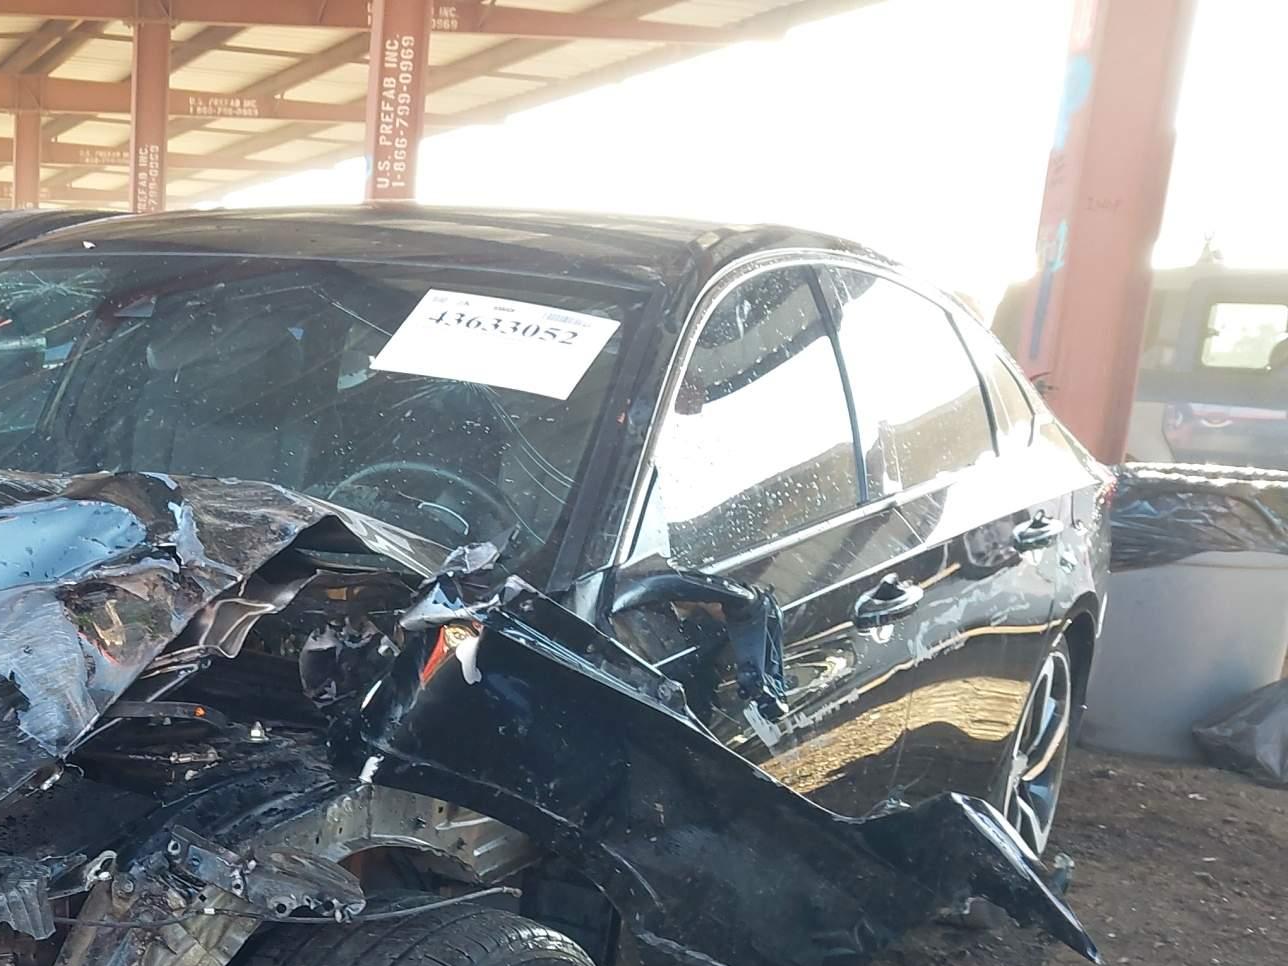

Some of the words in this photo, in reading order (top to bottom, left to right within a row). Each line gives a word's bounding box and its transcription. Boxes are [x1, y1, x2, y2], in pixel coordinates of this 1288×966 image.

[384, 33, 400, 68] INC.
[378, 77, 397, 146] PREFAB
[391, 35, 415, 187] 1-866-799-0969
[376, 155, 392, 189] U.S.
[428, 310, 579, 346] 43633052
